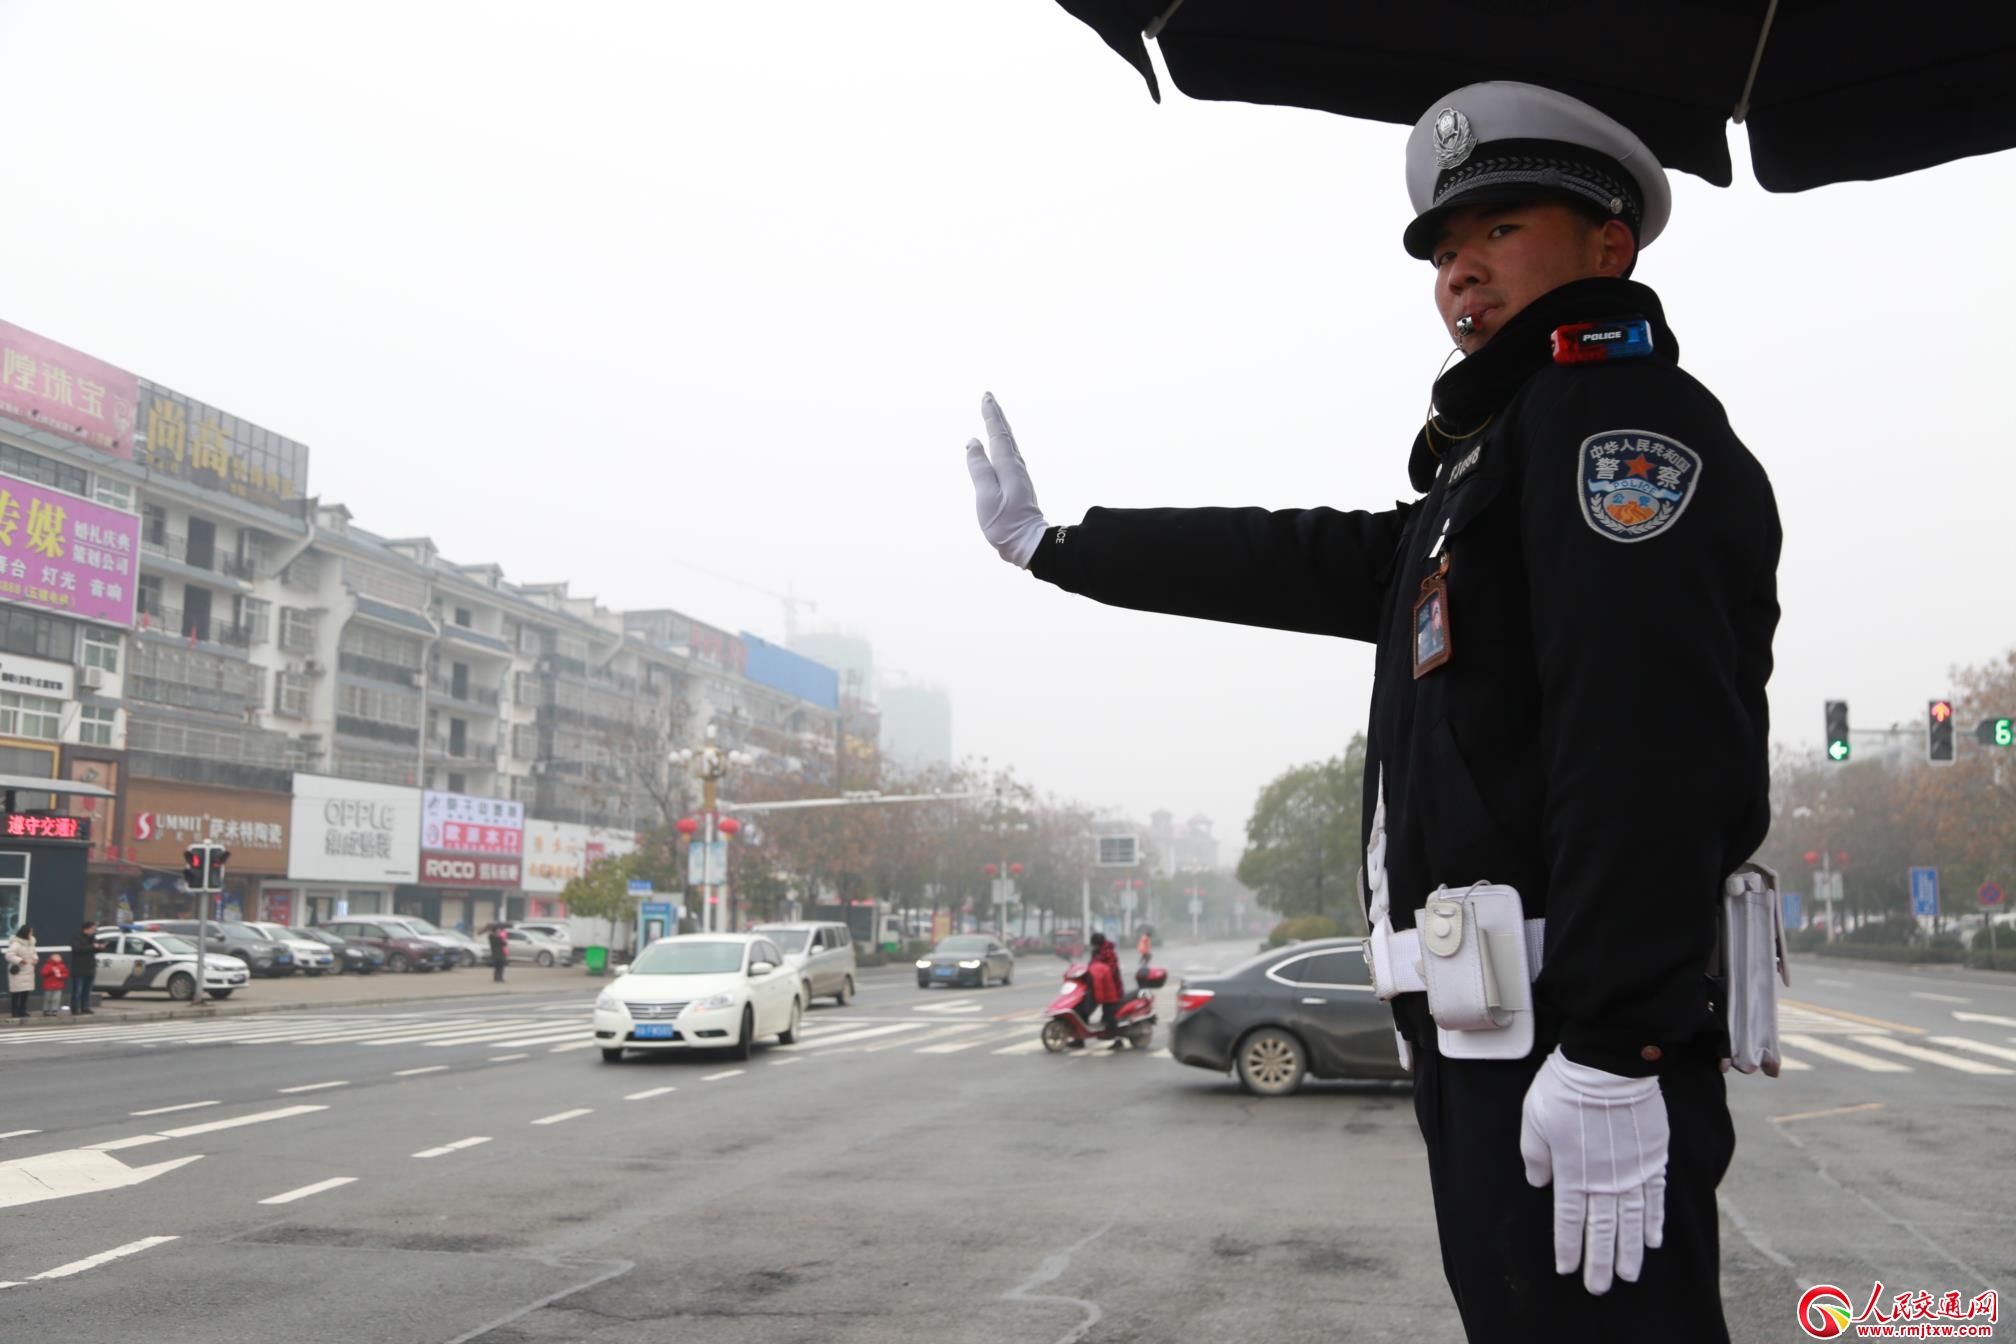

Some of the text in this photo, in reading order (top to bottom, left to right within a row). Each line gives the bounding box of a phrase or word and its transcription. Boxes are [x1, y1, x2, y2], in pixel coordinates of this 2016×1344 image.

[1582, 331, 1623, 342] POLICE
[1589, 438, 1692, 474] 中华人民共和国
[1595, 457, 1682, 490] 警 察
[1613, 480, 1658, 496] POLICE
[1995, 719, 2012, 746] 6
[425, 859, 477, 880] ROCO
